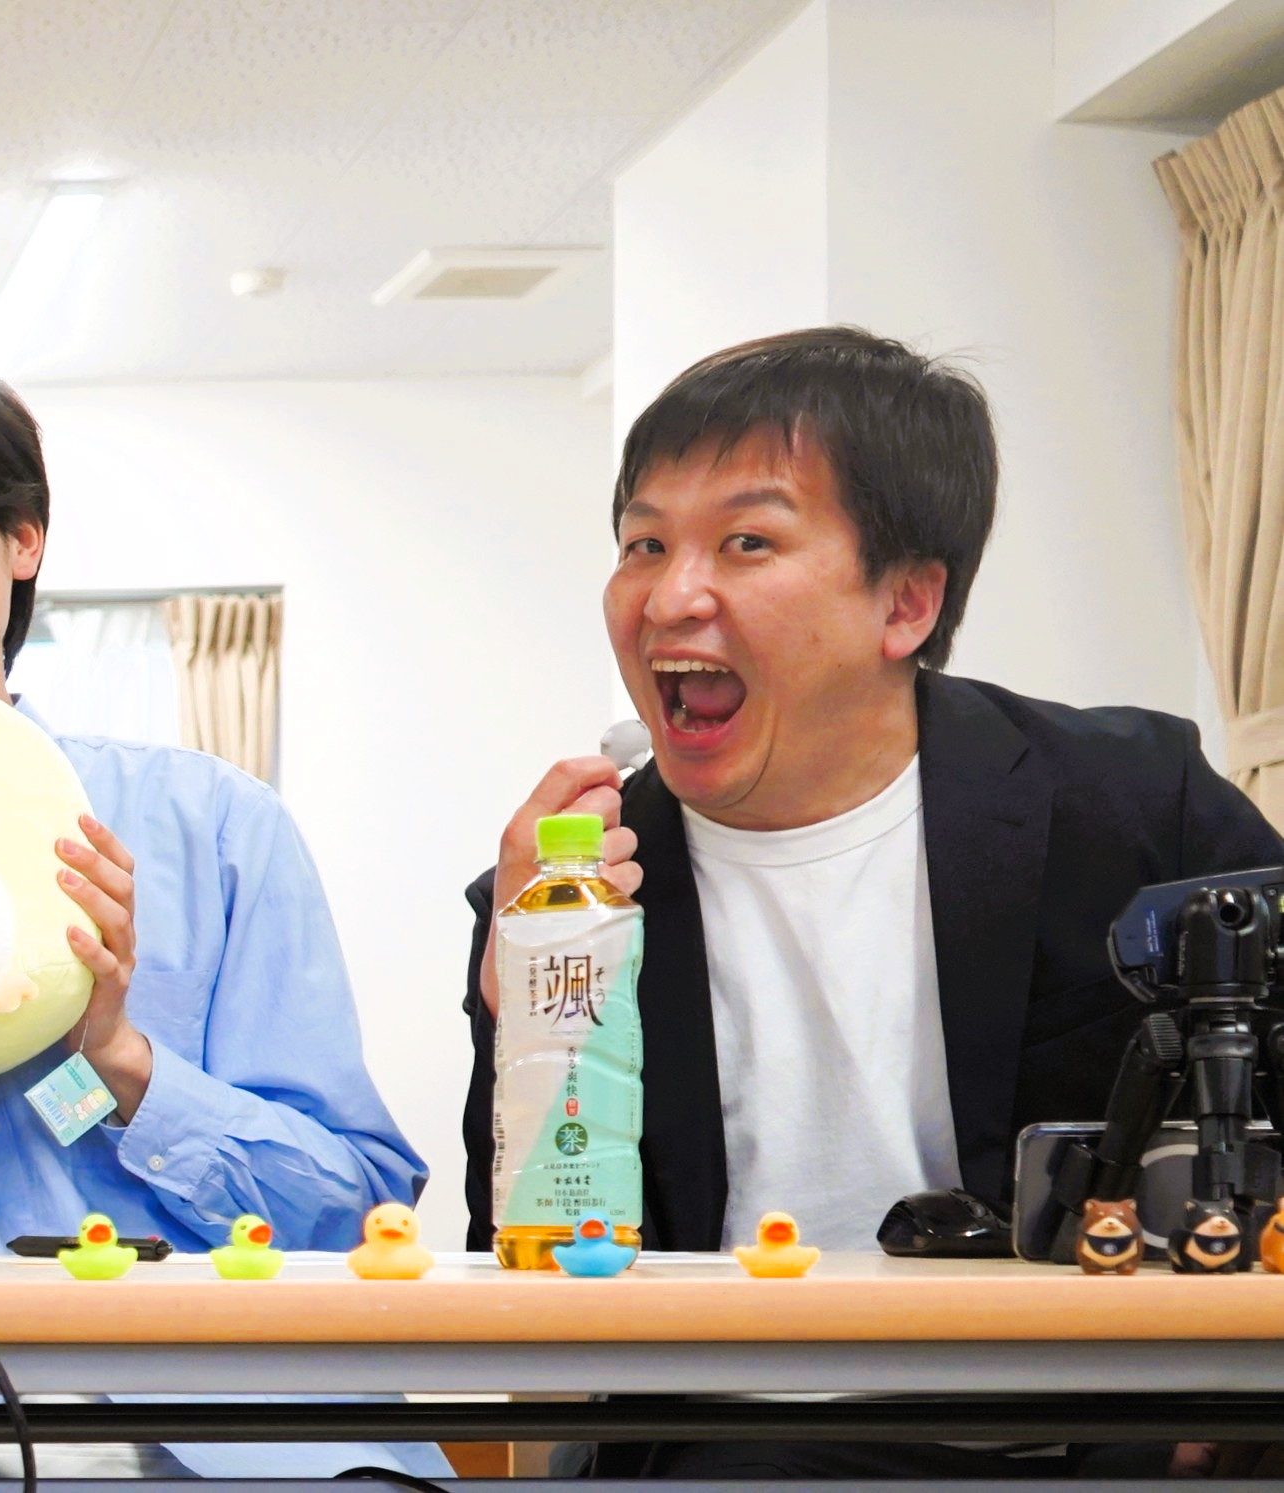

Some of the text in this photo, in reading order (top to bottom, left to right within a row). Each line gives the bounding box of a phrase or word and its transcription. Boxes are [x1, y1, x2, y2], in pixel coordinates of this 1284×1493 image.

[543, 954, 604, 1027] 颯
[594, 966, 605, 1006] そう
[566, 1046, 578, 1096] 香る爽快
[560, 1125, 585, 1153] 茶
